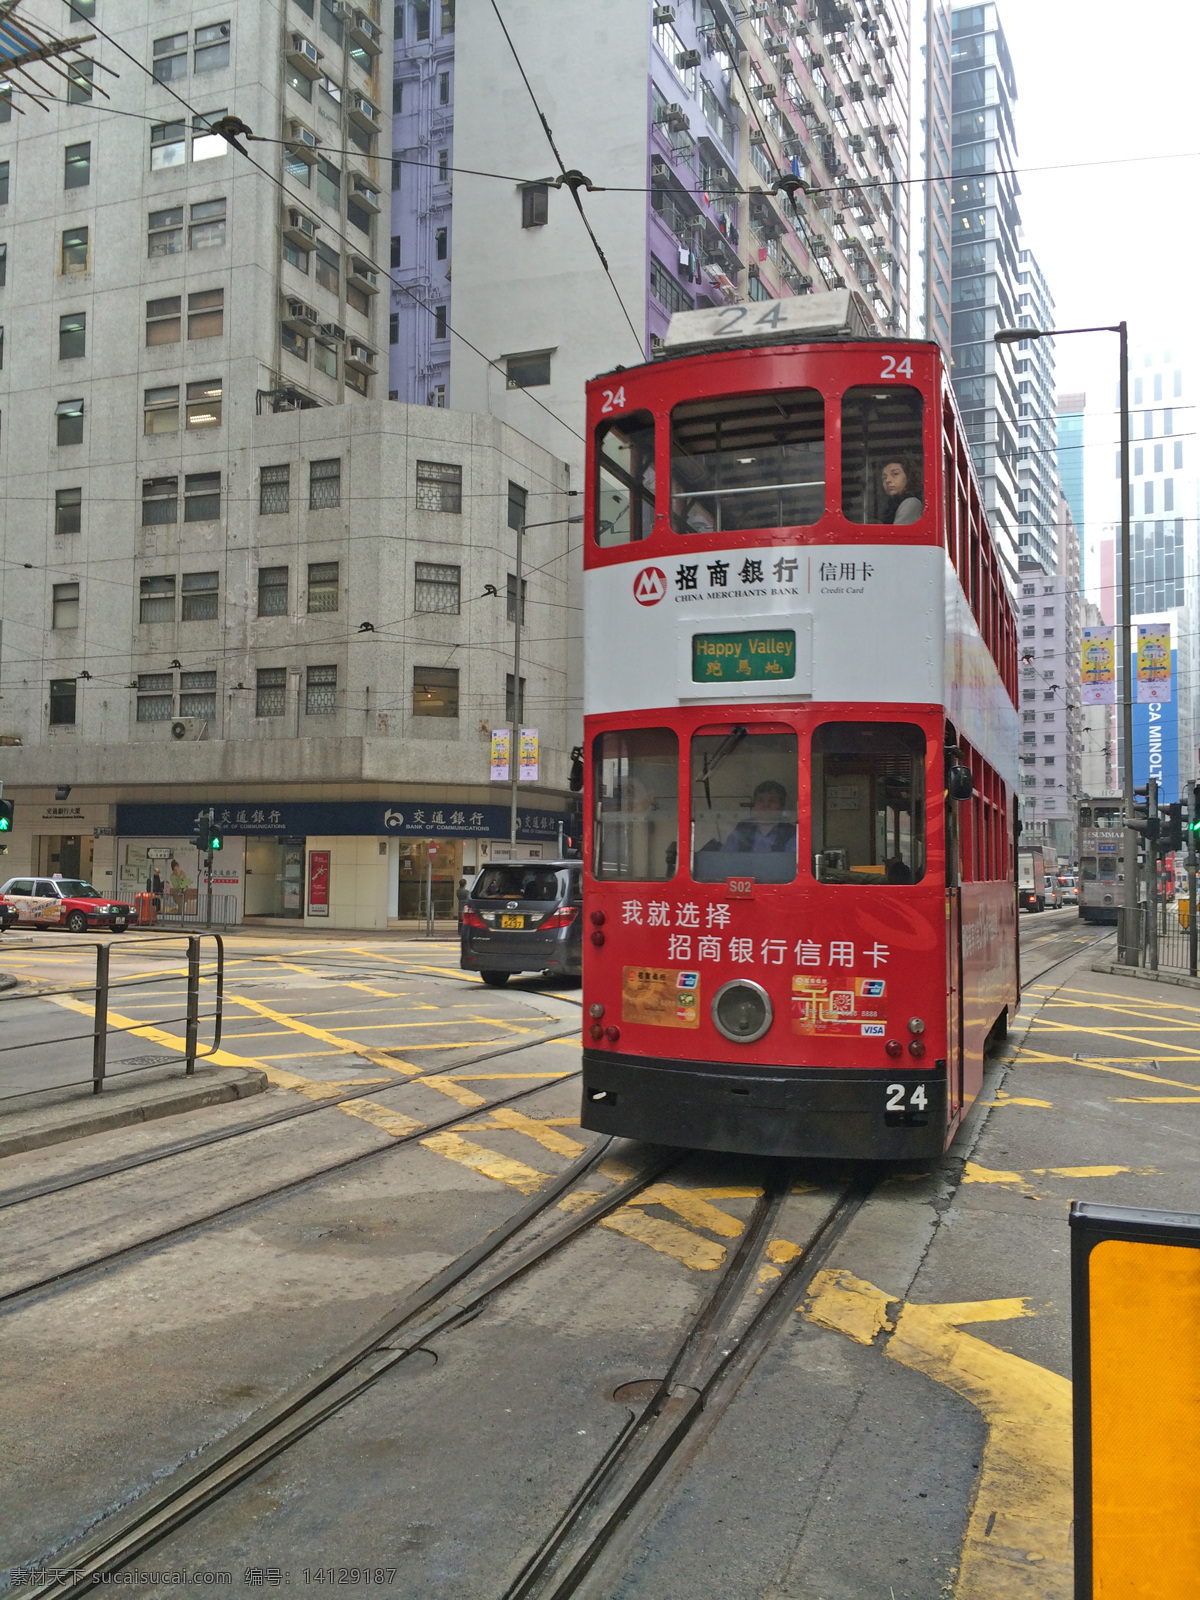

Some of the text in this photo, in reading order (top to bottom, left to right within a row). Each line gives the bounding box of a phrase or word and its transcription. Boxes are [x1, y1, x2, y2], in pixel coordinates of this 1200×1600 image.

[713, 302, 787, 336] 24
[880, 355, 914, 379] 24
[601, 386, 626, 413] 24
[675, 557, 799, 591] 招商銀行
[818, 562, 875, 582] 信用卡
[675, 588, 799, 603] CHINA MERCHANTS BANK
[697, 638, 793, 659] Happy Valley
[705, 659, 783, 677] 跑馬地
[1148, 702, 1162, 722] CA
[221, 809, 281, 823] 交通銀行
[413, 809, 484, 825] 交通銀行
[525, 815, 555, 829] 交通銀行
[729, 881, 752, 893] S02
[622, 899, 731, 929] 我就选择
[667, 933, 890, 968] 招商银行信用卡
[864, 1026, 884, 1034] VISA
[886, 1084, 928, 1110] 24
